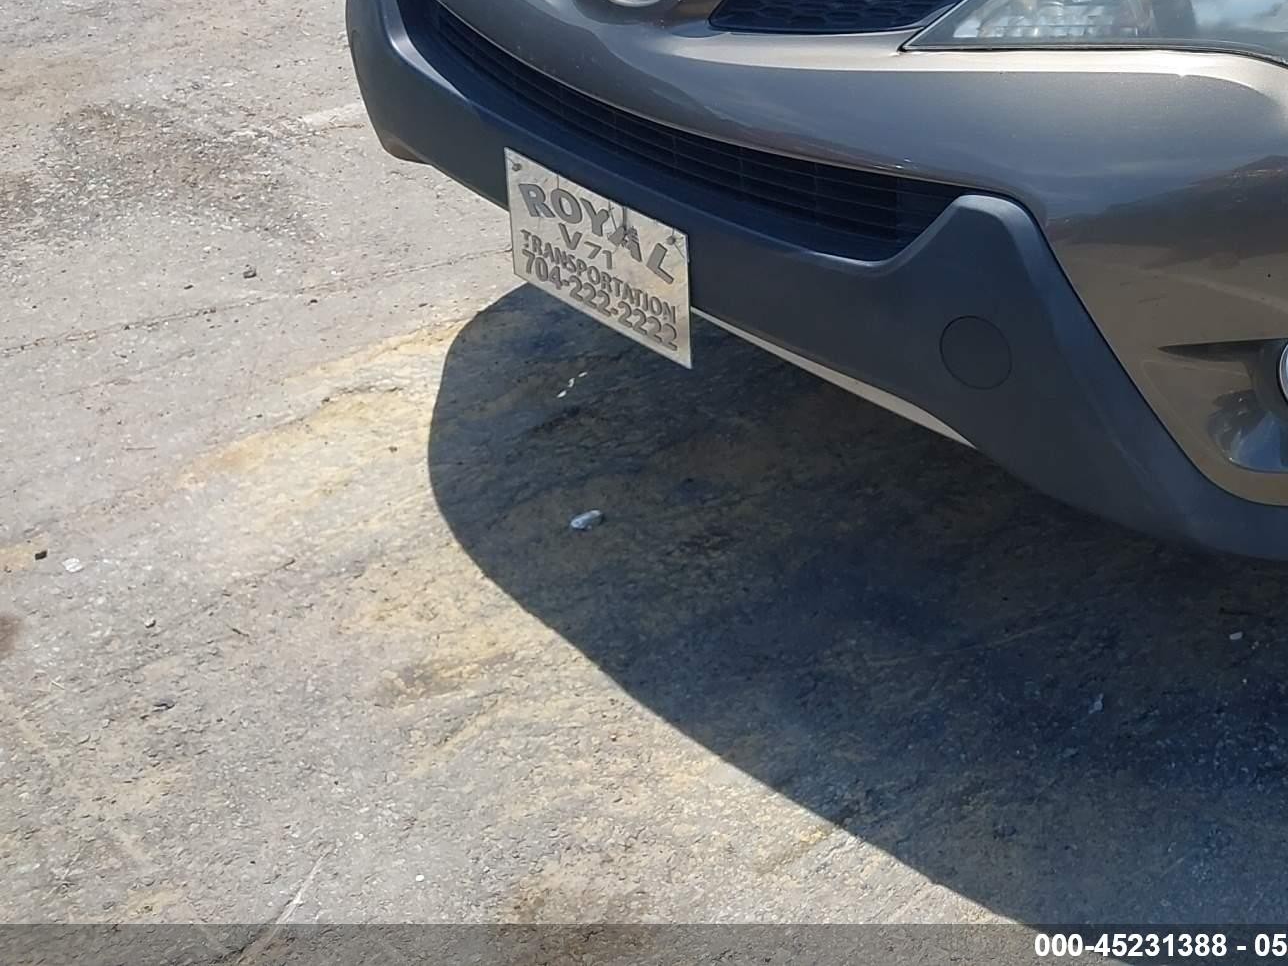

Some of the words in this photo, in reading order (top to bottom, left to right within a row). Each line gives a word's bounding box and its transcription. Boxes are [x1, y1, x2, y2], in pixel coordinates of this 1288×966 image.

[517, 183, 674, 285] ROYAL
[520, 228, 676, 324] TRANSPORTATION
[522, 249, 678, 351] 704-222-2222
